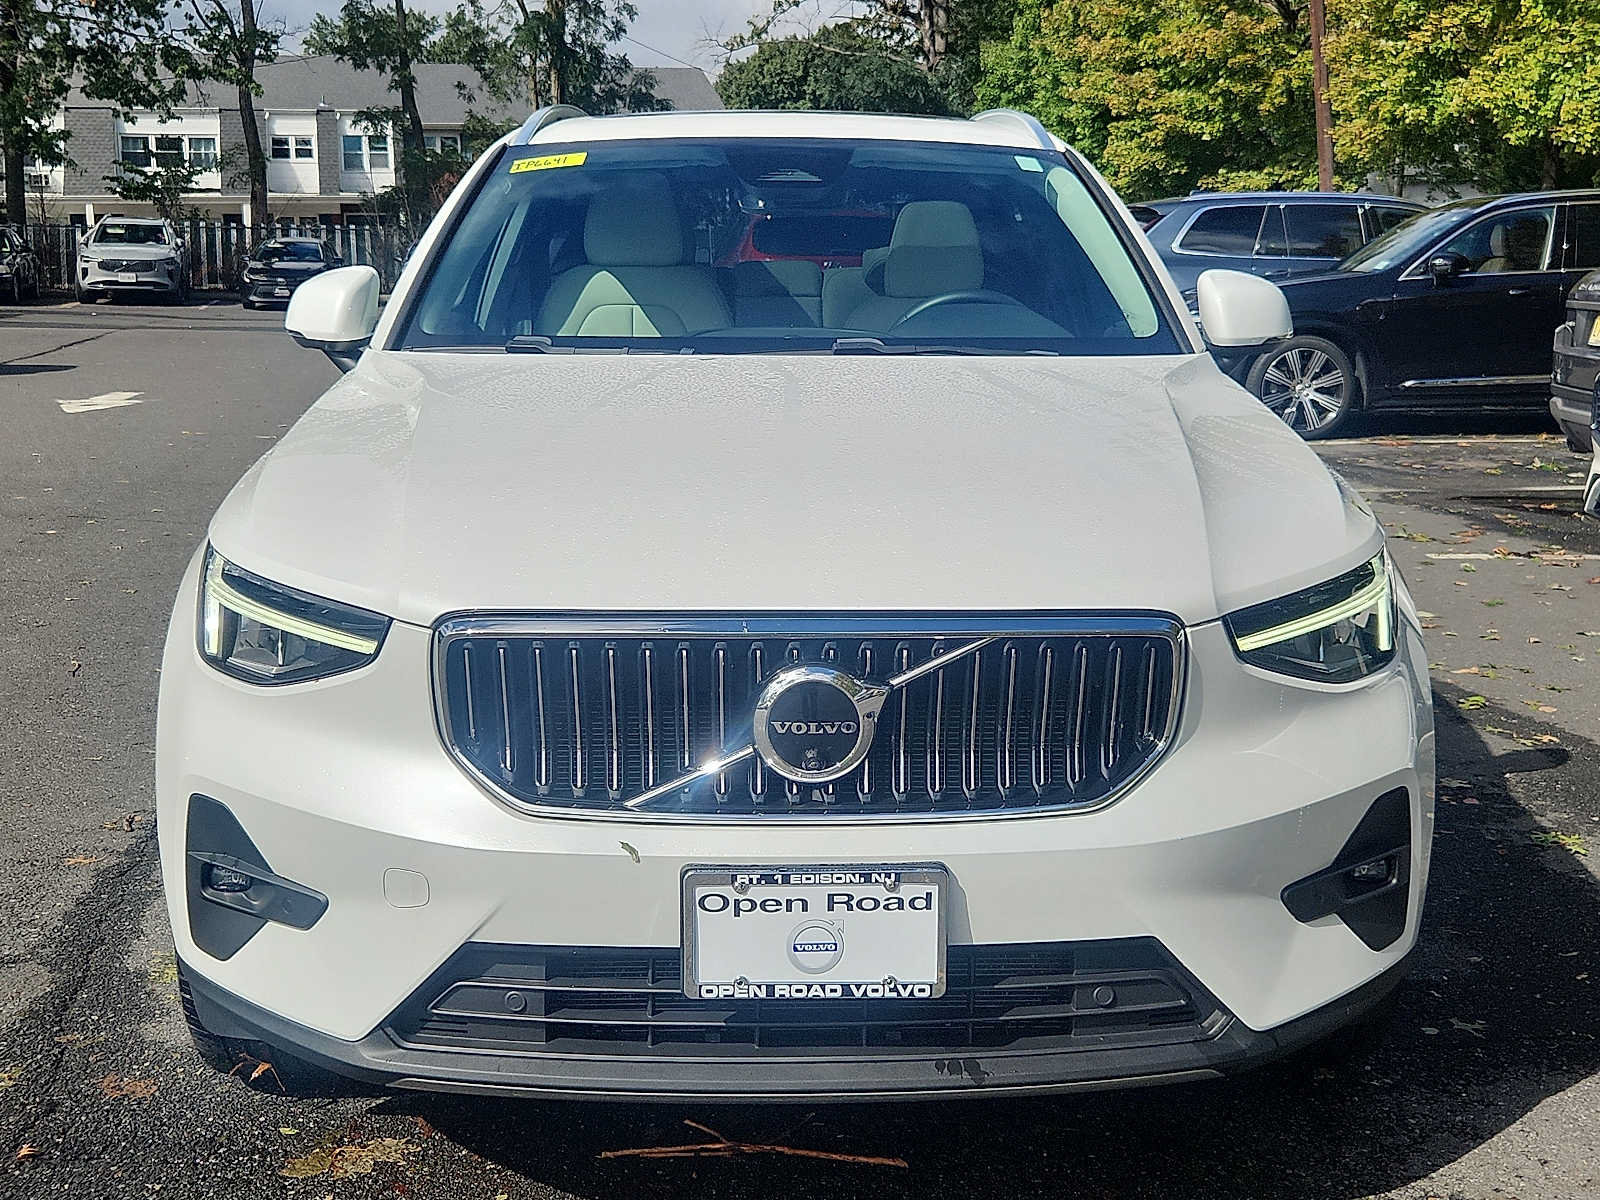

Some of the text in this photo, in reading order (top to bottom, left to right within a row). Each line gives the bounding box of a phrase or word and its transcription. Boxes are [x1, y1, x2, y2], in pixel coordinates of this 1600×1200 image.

[770, 721, 858, 735] VOLVO
[736, 872, 896, 885] RT. 1 EDISON, NJ
[698, 891, 933, 918] Open Road
[794, 943, 836, 952] VOLVO
[700, 984, 932, 998] OPEN ROAD VOLVO
